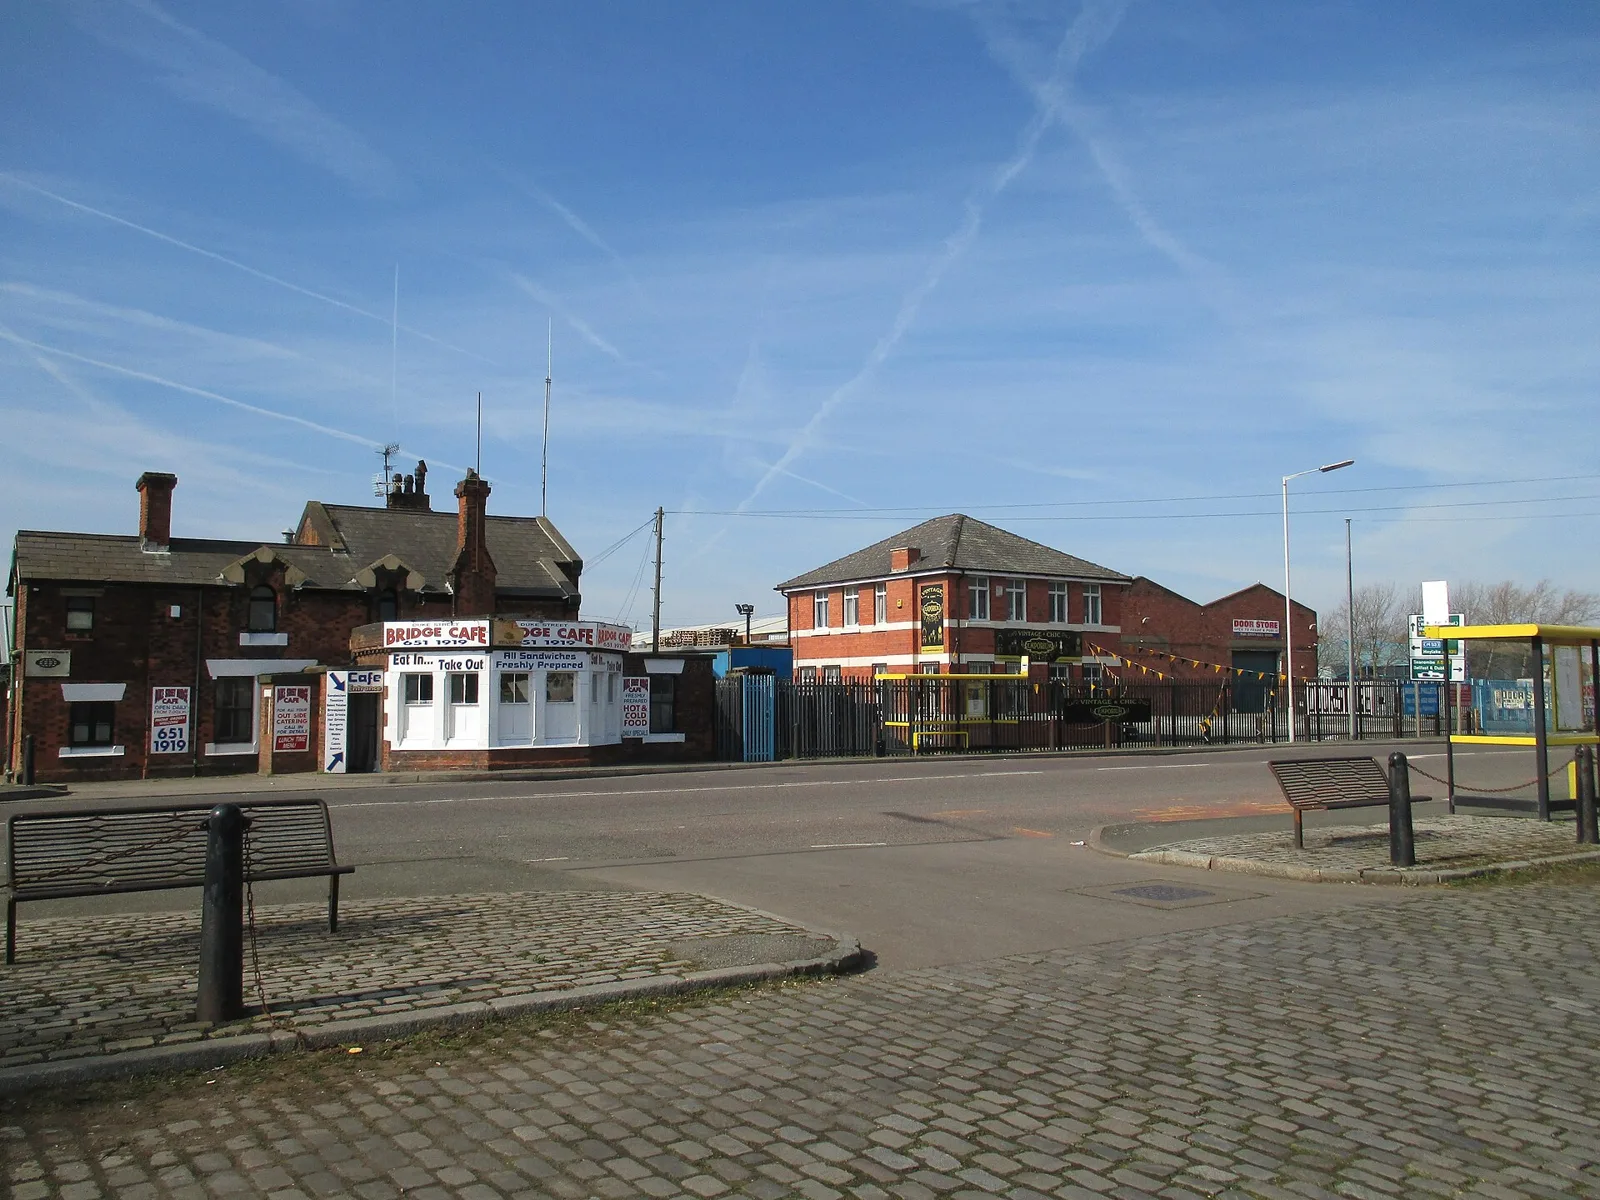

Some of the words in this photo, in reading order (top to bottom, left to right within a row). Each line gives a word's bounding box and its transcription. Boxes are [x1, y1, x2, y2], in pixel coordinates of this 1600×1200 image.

[922, 587, 943, 596] VINTAGE
[1234, 620, 1255, 628] DOOR
[1255, 621, 1278, 629] STORE
[386, 627, 442, 646] BRIDGE
[449, 627, 487, 644] CAFE
[557, 628, 594, 645] CAFE
[598, 629, 617, 645] BRIDGE
[393, 654, 410, 666] Eat
[503, 652, 517, 660] All
[519, 652, 577, 661] Sandwiches
[438, 659, 462, 671] Take
[465, 658, 484, 670] Out
[495, 661, 533, 671] Freshly
[537, 661, 583, 671] Prepared
[348, 672, 382, 685] Cafe
[158, 728, 183, 739] 651
[153, 740, 187, 751] 1919
